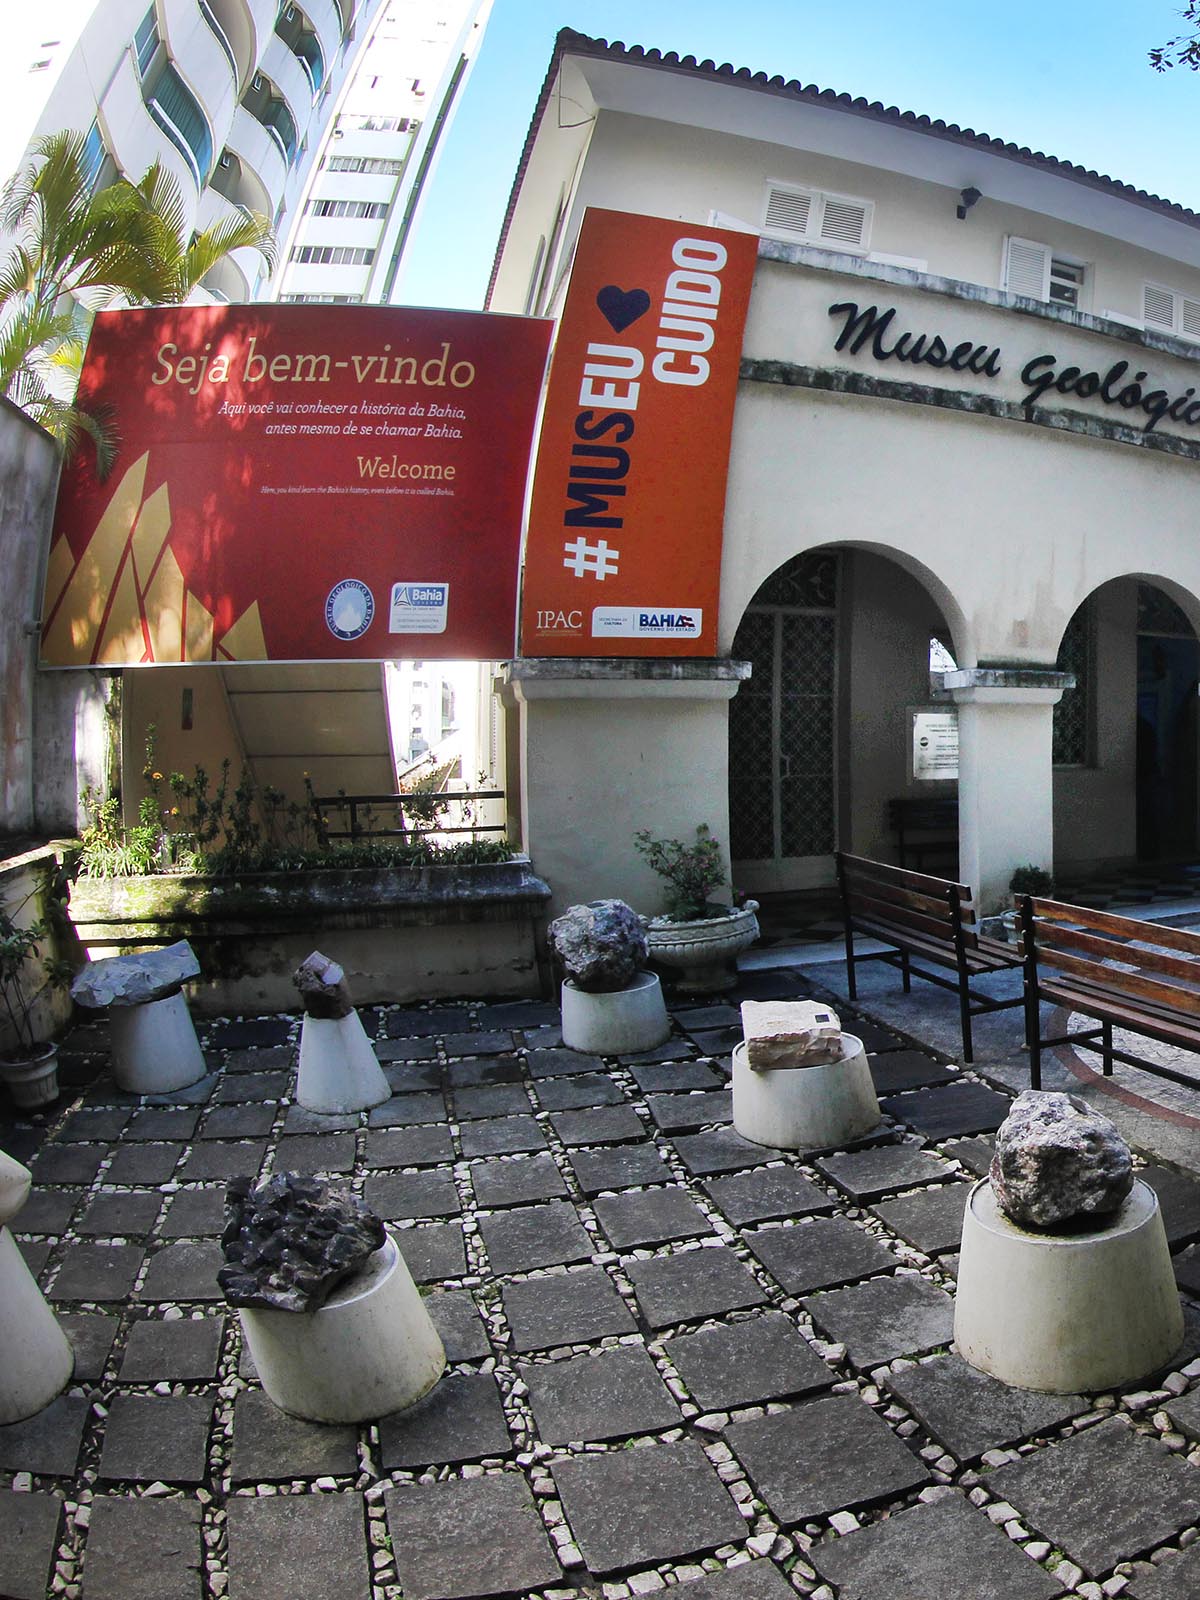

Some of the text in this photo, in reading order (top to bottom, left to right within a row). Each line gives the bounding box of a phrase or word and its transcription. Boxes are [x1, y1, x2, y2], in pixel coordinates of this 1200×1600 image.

[652, 237, 728, 387] CUIDO
[828, 302, 1001, 378] Museu
[151, 337, 476, 395] Seja bem-vindo
[218, 400, 466, 419] Aqui você vai conhecer a história da Bahia,
[265, 420, 463, 438] antes mesmo de se chamar Bahia.
[357, 455, 456, 480] Welcome
[412, 588, 443, 601] Bahia
[536, 610, 583, 629] IPAC
[639, 614, 695, 628] BAHIA
